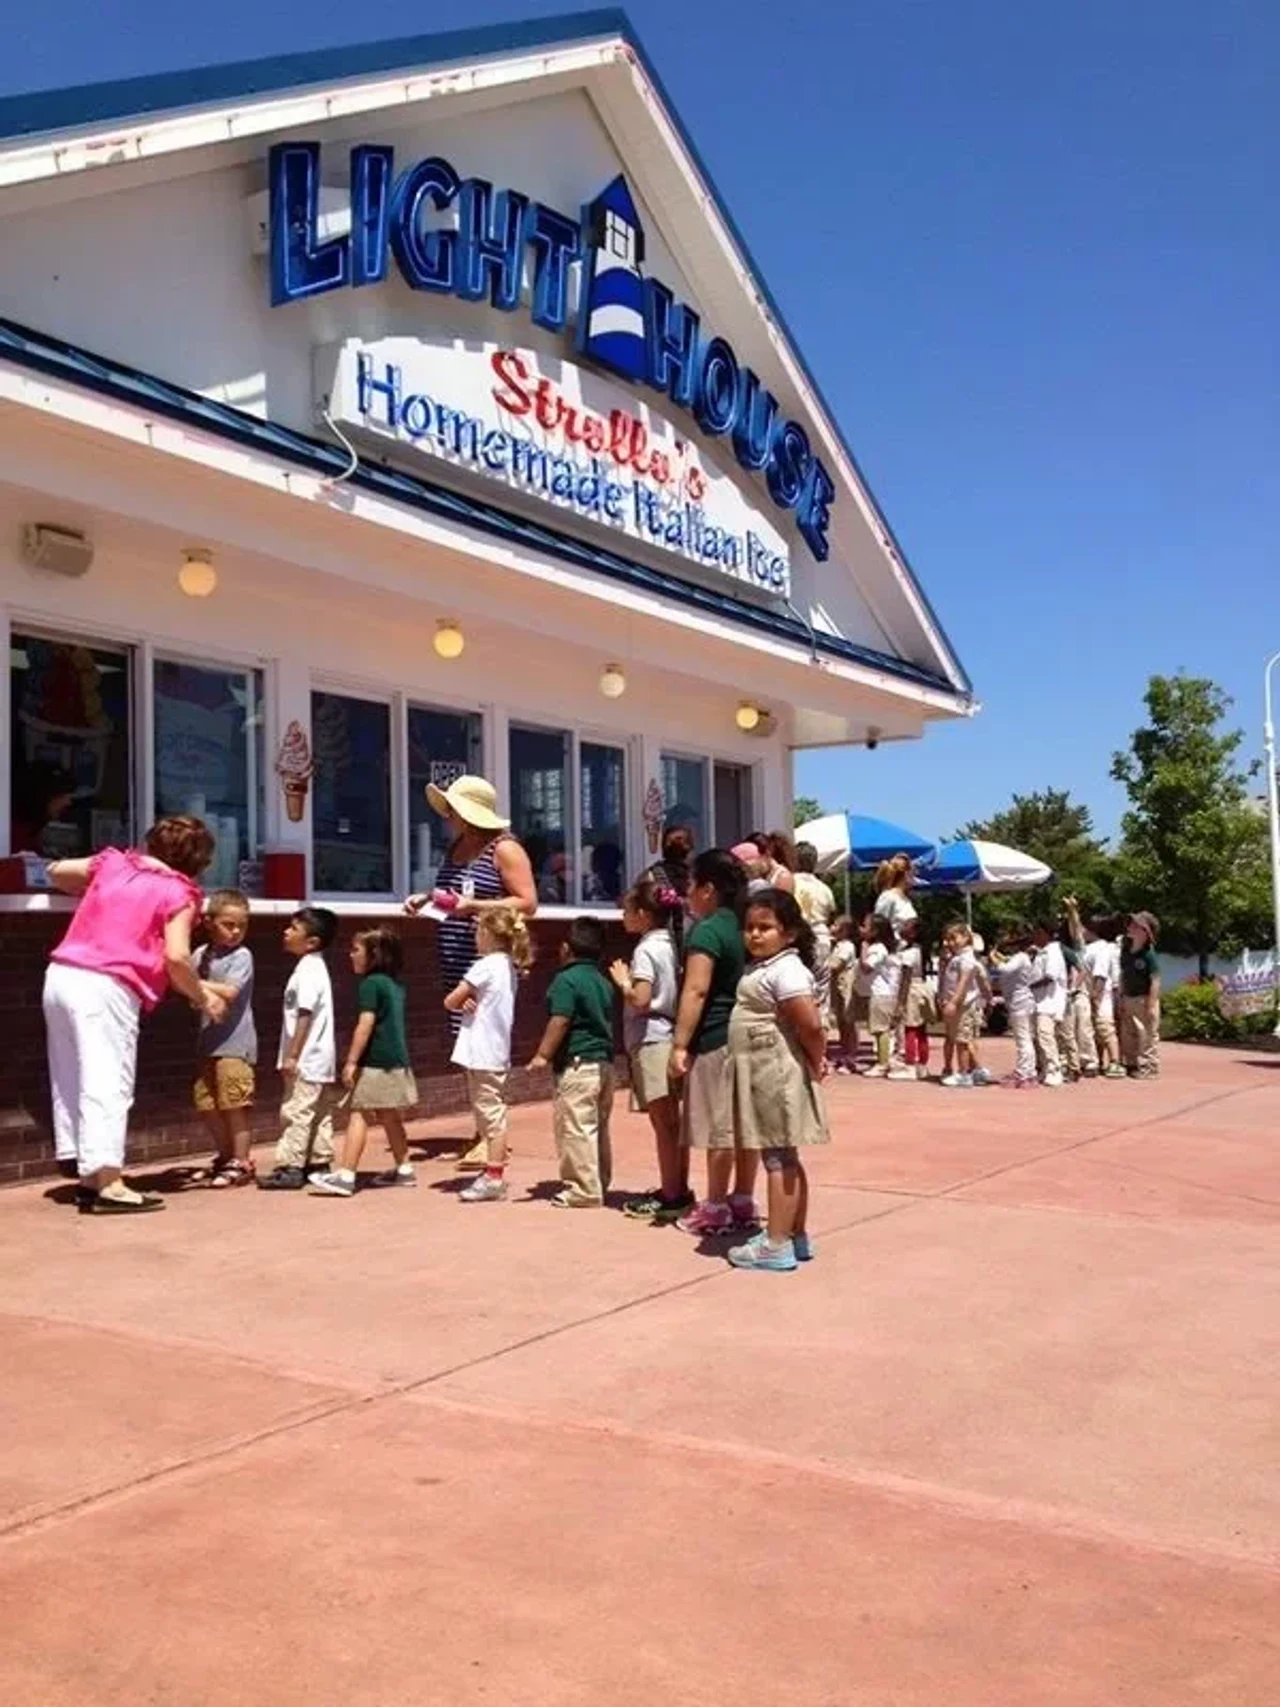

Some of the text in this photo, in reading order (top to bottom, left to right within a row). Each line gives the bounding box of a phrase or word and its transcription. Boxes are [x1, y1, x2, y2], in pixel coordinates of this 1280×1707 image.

[269, 141, 835, 562] LIGHT HOUSE
[357, 351, 786, 586] Homemade Italian Ice
[491, 352, 704, 500] Strollo's
